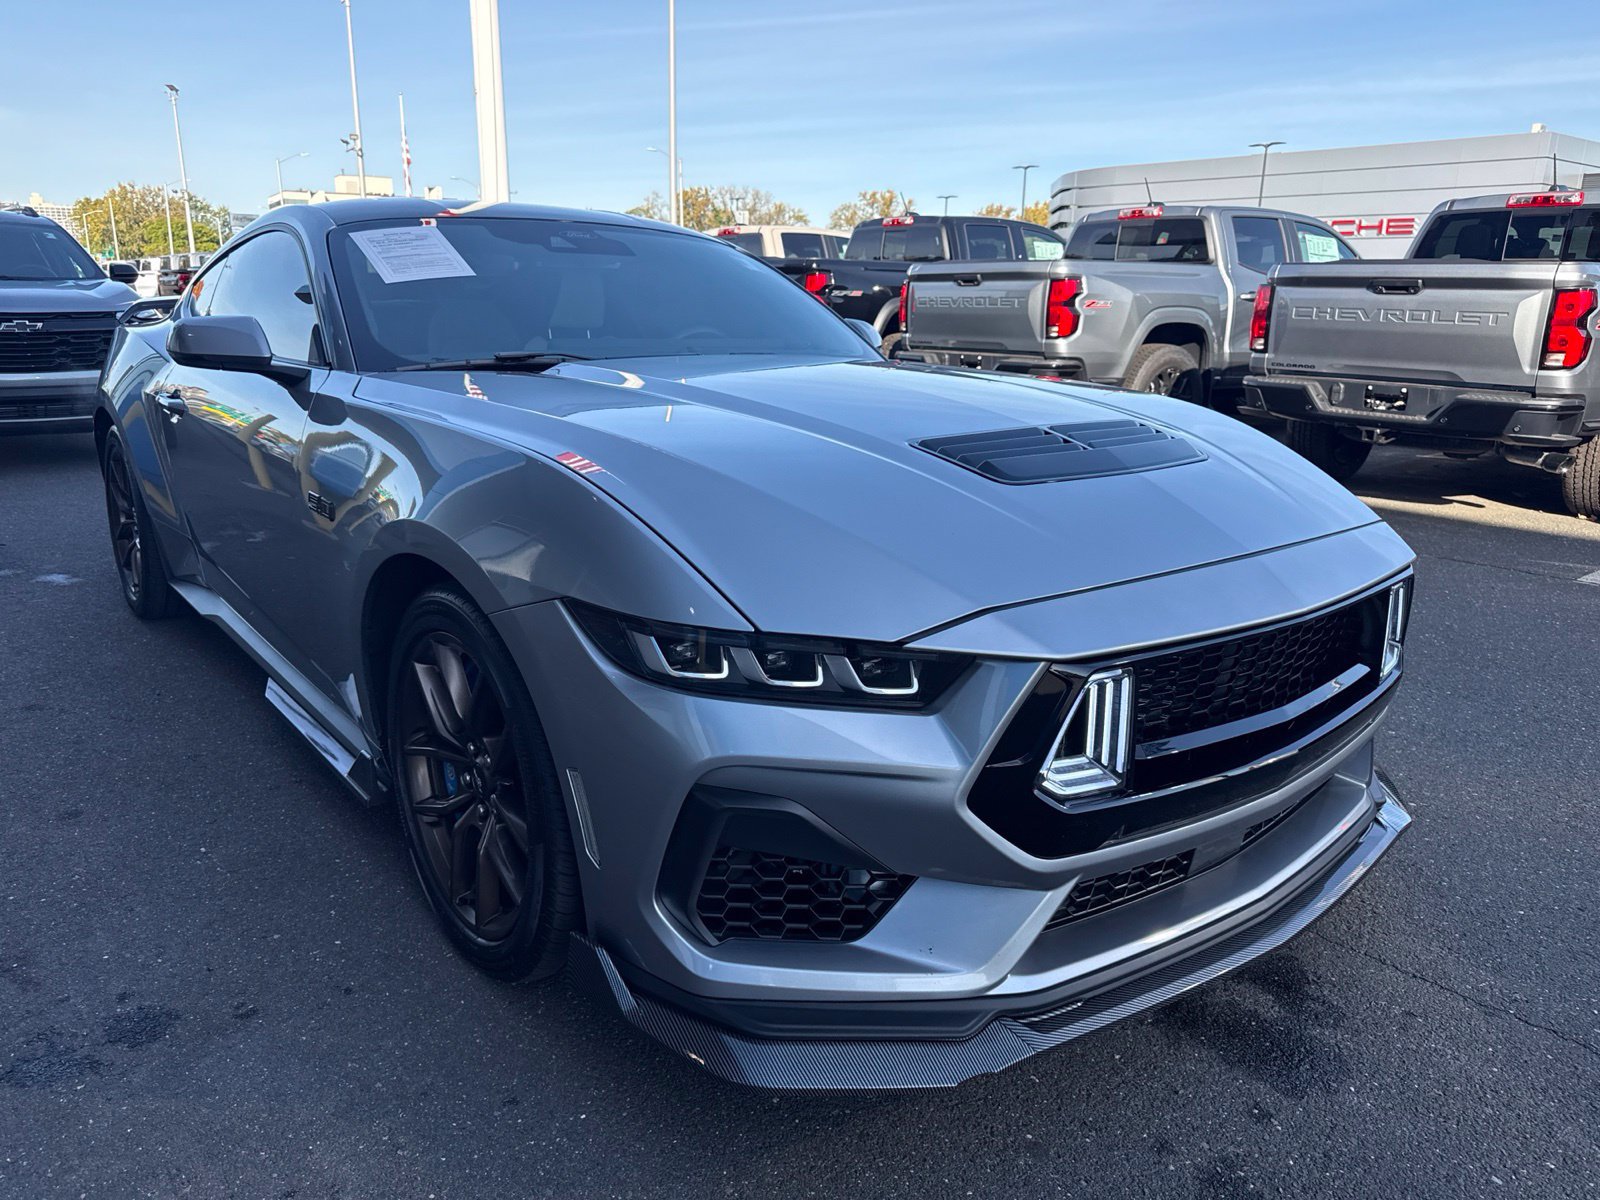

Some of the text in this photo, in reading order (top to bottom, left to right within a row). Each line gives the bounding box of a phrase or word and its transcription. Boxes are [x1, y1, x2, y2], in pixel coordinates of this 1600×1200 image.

[1329, 218, 1415, 236] CHE
[916, 296, 1025, 308] CHEVROLET
[1291, 306, 1509, 327] CHEVROLET
